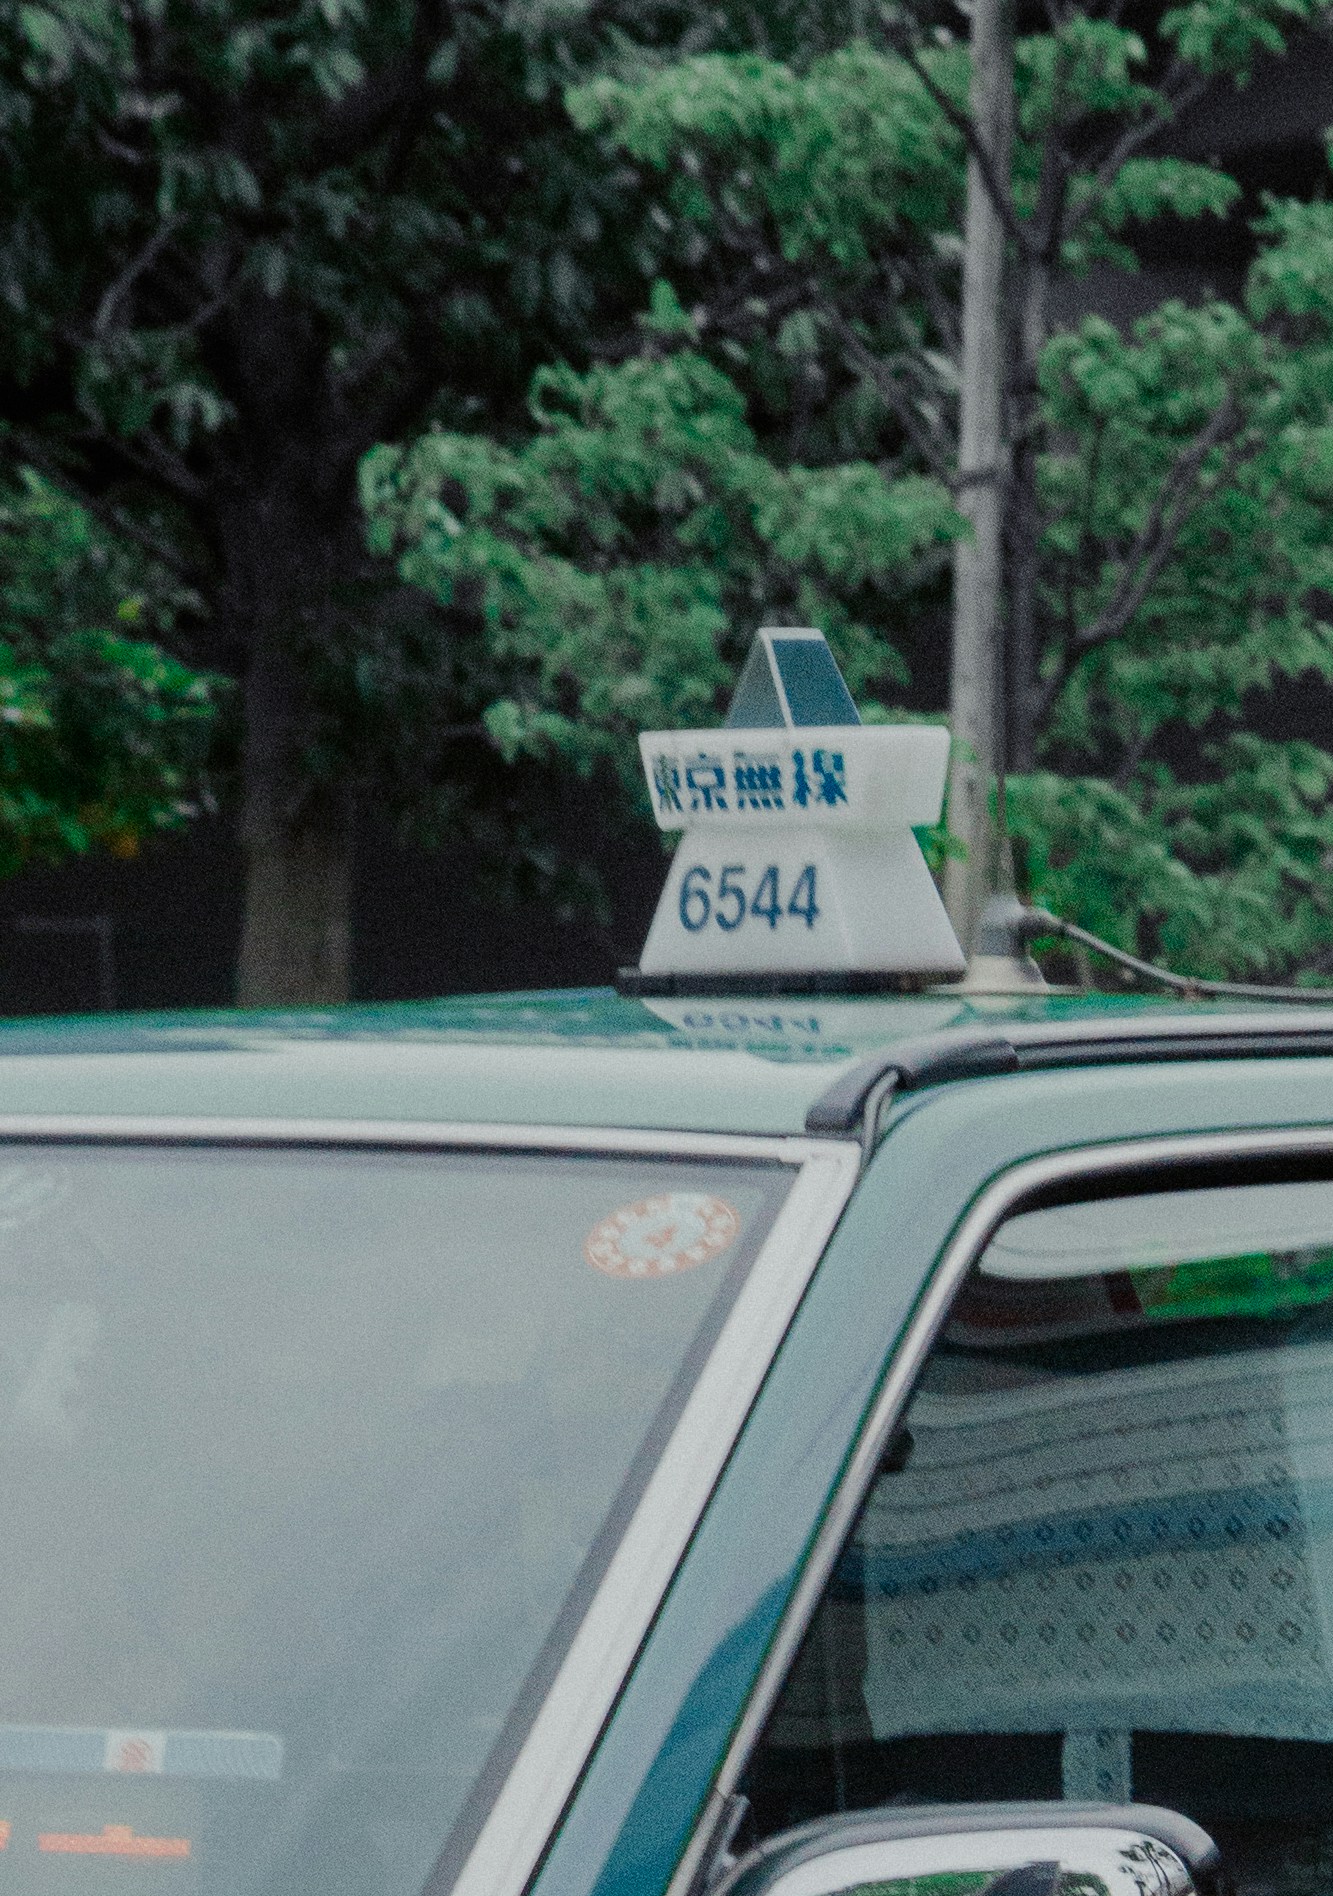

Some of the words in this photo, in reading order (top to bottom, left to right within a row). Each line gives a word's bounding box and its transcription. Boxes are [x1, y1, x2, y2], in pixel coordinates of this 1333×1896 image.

[652, 749, 849, 812] 東京無線
[679, 864, 820, 932] 6544
